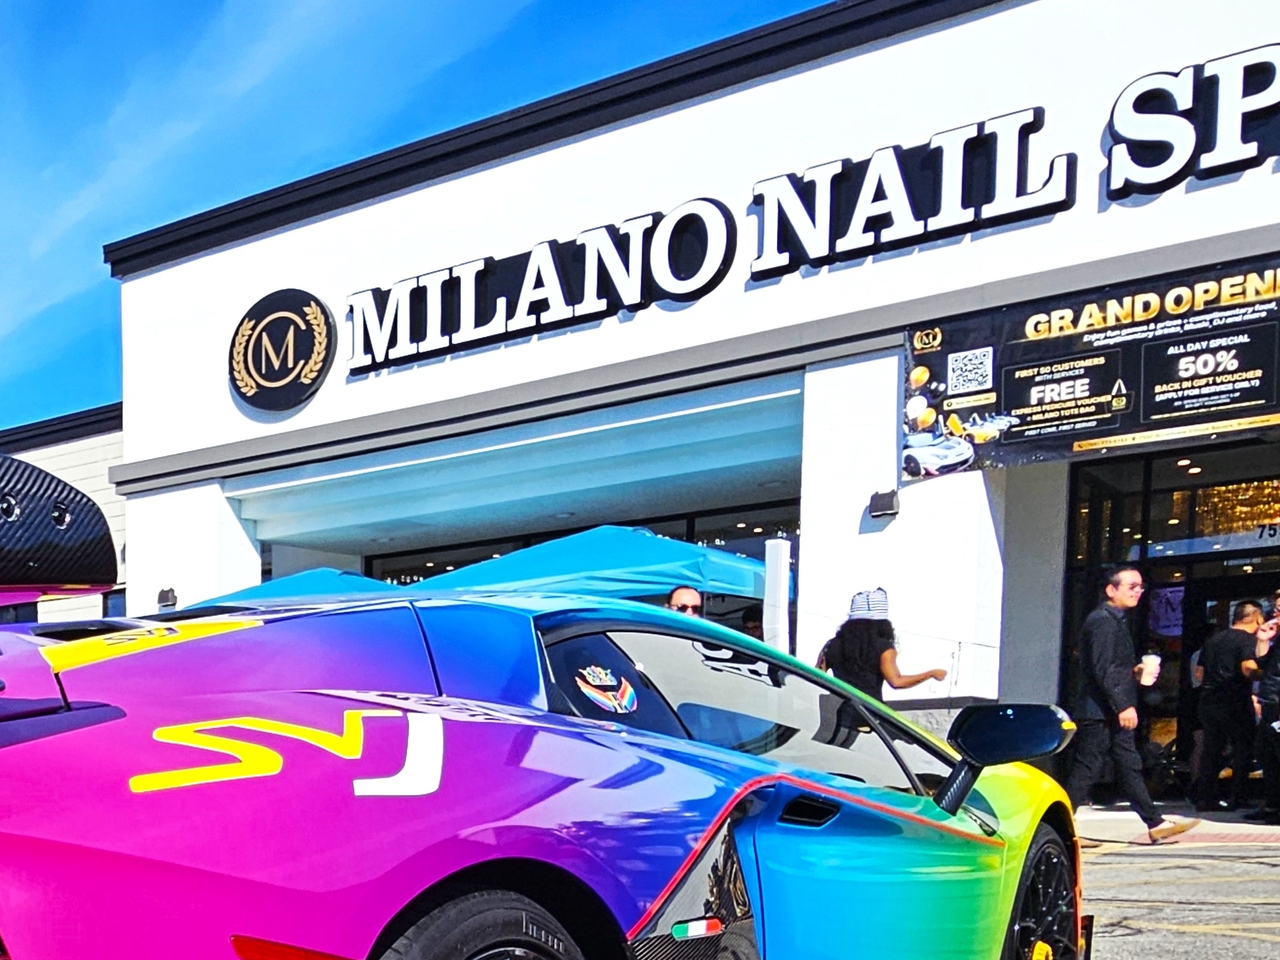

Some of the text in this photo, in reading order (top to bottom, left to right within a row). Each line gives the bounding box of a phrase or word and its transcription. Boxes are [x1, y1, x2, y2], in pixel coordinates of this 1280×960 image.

[346, 198, 730, 370] MILANO
[750, 108, 1070, 272] NAIL
[1025, 292, 1161, 341] GRAND
[1167, 333, 1252, 355] ALL DAY SPECIAL
[1015, 356, 1106, 379] FIRST 50 CUSTOMERS
[1178, 349, 1240, 378] 50%
[1030, 378, 1091, 405] FREE
[1154, 382, 1181, 393] BACK
[1192, 376, 1214, 387] GIFT
[1214, 369, 1263, 384] VOUCHER
[1031, 411, 1060, 421] MILANO
[1257, 522, 1280, 540] 75
[128, 709, 444, 797] SVJ
